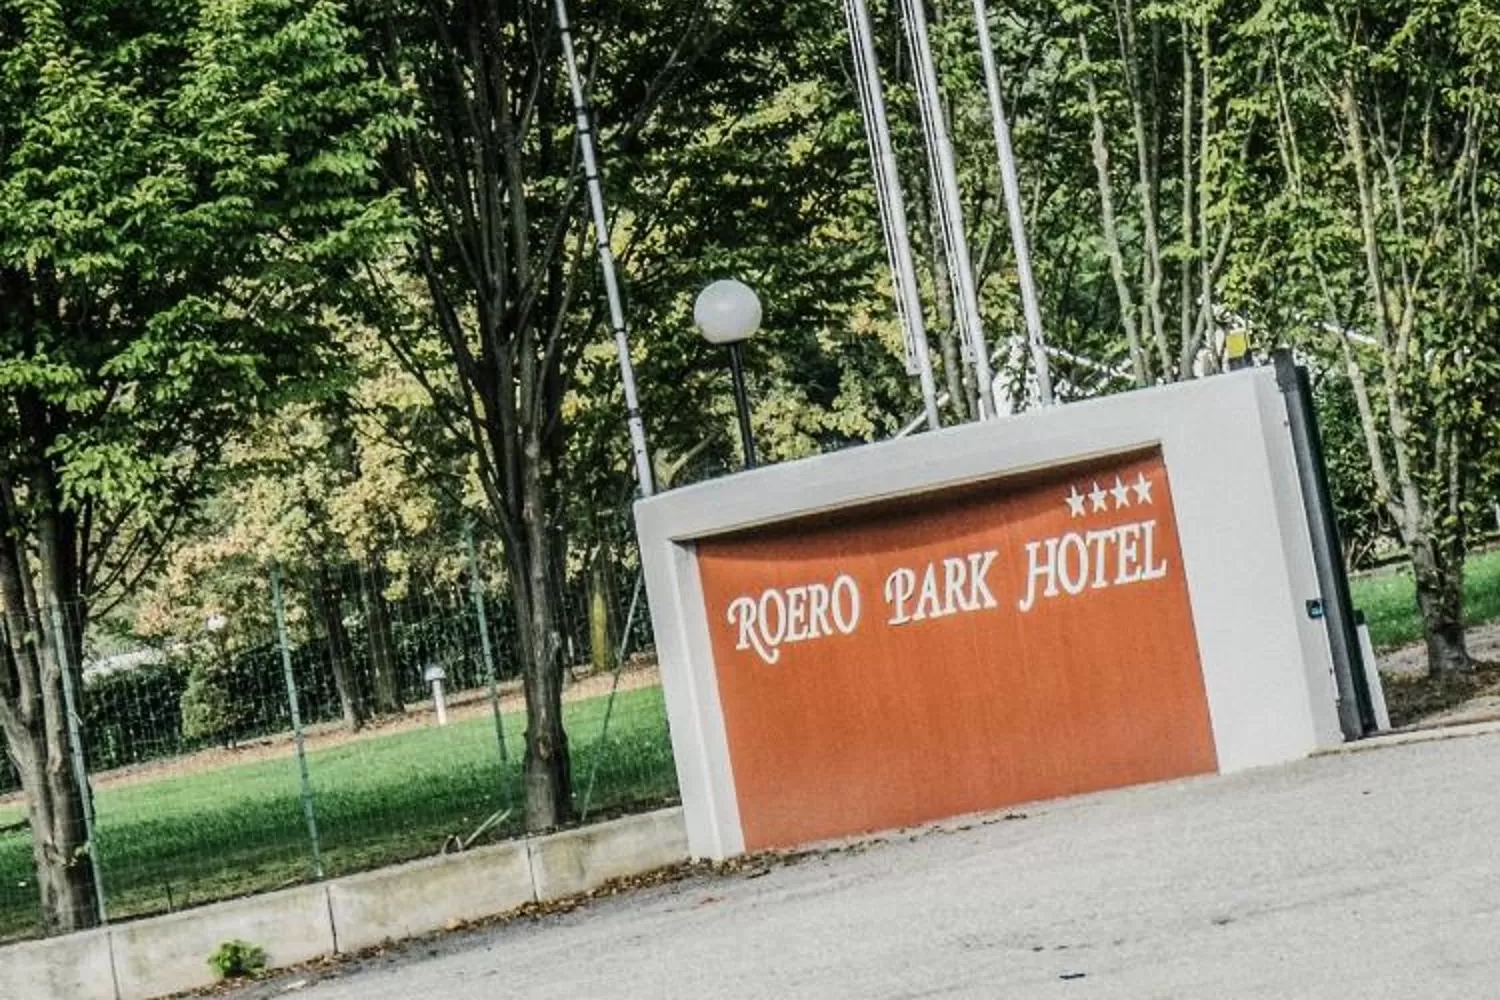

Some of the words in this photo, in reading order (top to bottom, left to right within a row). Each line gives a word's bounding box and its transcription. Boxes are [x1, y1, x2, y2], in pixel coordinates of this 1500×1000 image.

[727, 574, 860, 664] ROERO
[885, 551, 998, 626] PARK
[1020, 520, 1167, 612] HOTEL
